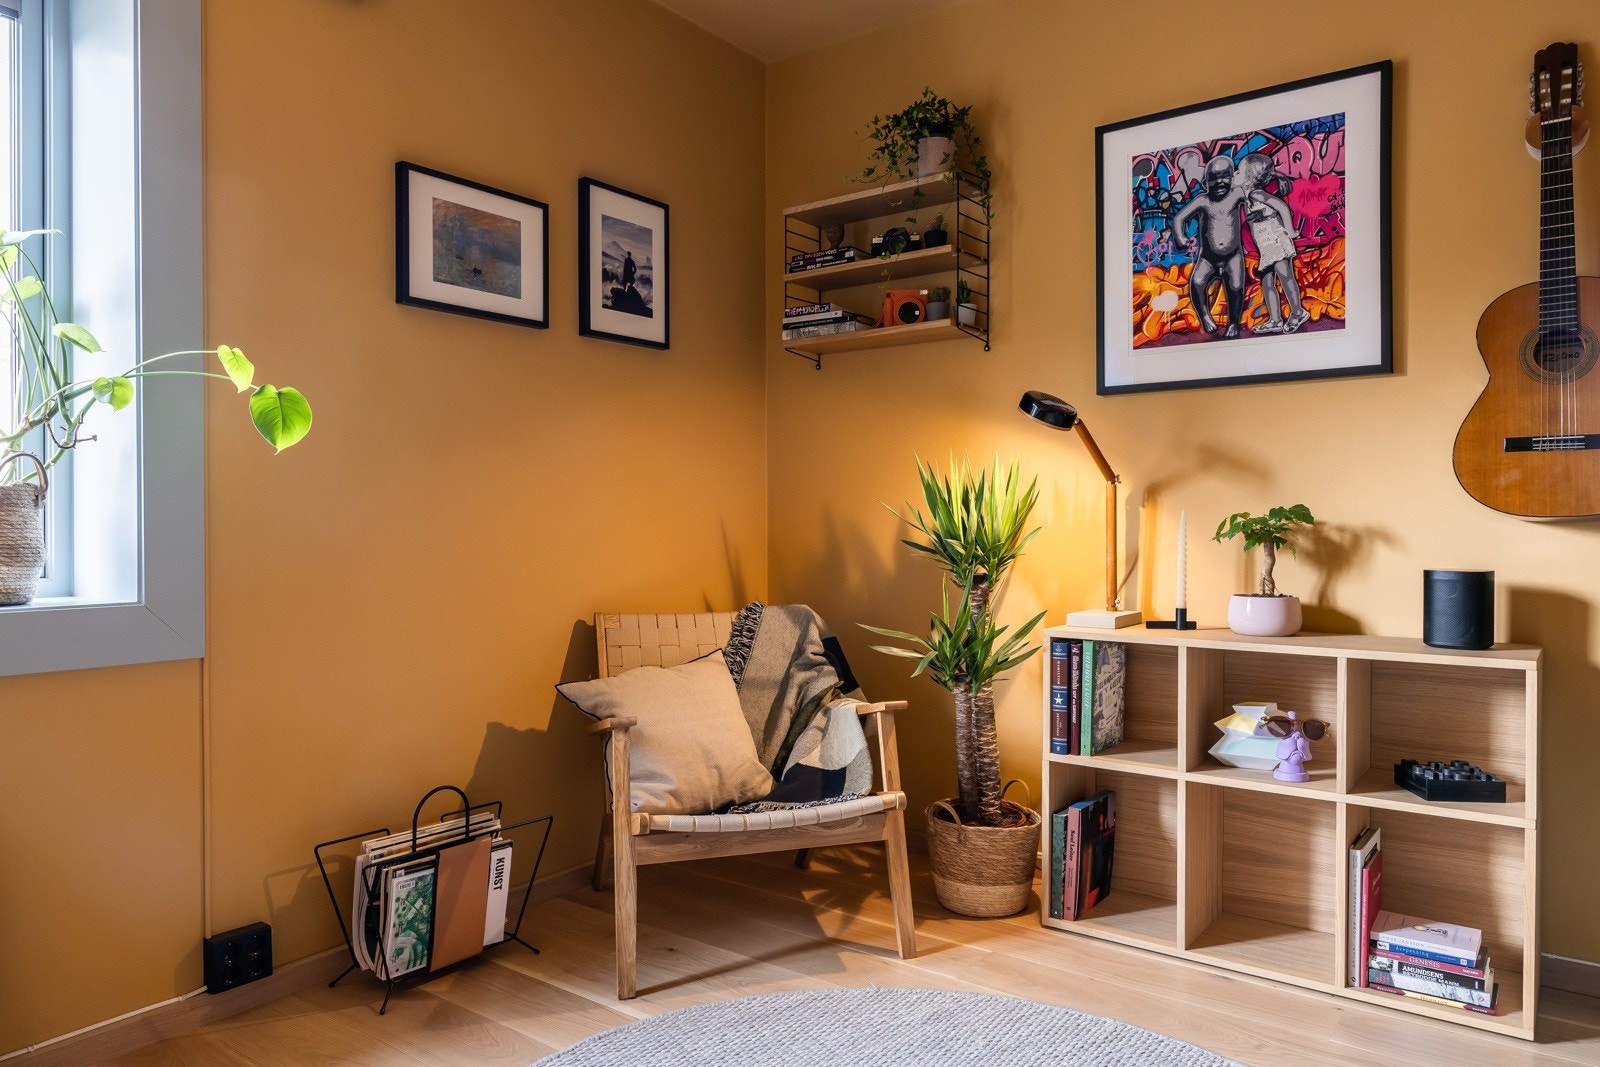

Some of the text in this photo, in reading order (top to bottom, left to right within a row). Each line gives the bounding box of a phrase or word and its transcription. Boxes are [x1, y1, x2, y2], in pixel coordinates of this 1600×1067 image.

[493, 857, 505, 890] KUNST
[1399, 938, 1424, 947] JANSSON
[1409, 957, 1441, 968] GENESIS
[1402, 965, 1444, 979] AMUNDSENS
